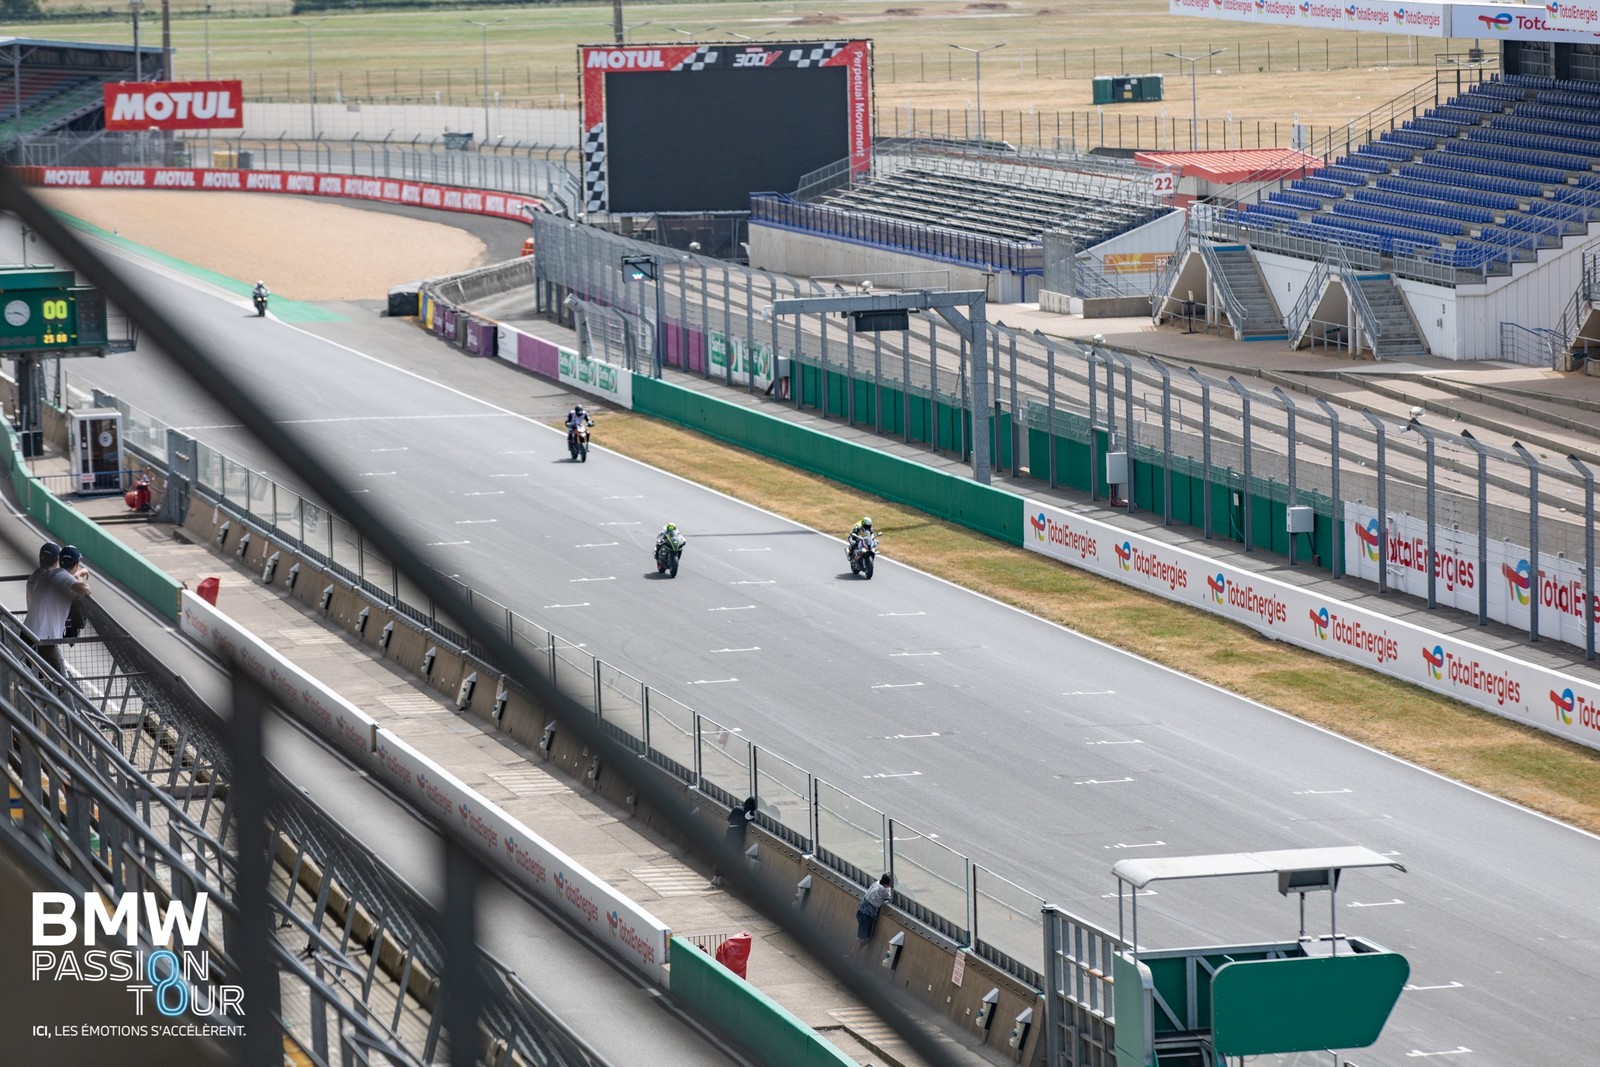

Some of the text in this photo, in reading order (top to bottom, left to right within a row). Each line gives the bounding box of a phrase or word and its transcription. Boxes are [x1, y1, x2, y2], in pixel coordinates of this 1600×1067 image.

[1309, 4, 1342, 21] TotalEnergies
[1355, 7, 1389, 25] TotalEnergies
[1405, 10, 1440, 29] TotalEnergies
[1559, 4, 1598, 24] TotalEnergies
[587, 50, 783, 69] MOTUL 300V
[112, 91, 236, 121] MOTUL
[853, 50, 865, 157] Perpetual Movement
[44, 170, 91, 185] MOTUL
[101, 170, 146, 186] MOTUL
[153, 171, 195, 187] MOTUL
[203, 171, 241, 188] MOTUL
[246, 173, 282, 190] MOTUL
[286, 174, 315, 192] MOTUL
[1155, 176, 1173, 191] 22
[43, 300, 68, 320] 00
[1046, 518, 1097, 559] TotalEnergies
[1132, 547, 1188, 591] TotalEnergies
[1226, 579, 1287, 625] TotalEnergies
[1330, 613, 1398, 664] TotalEnergies
[1446, 653, 1520, 705] TotalEnergies
[564, 878, 599, 922] TotalEnergies
[618, 918, 655, 965] TotalEnergies
